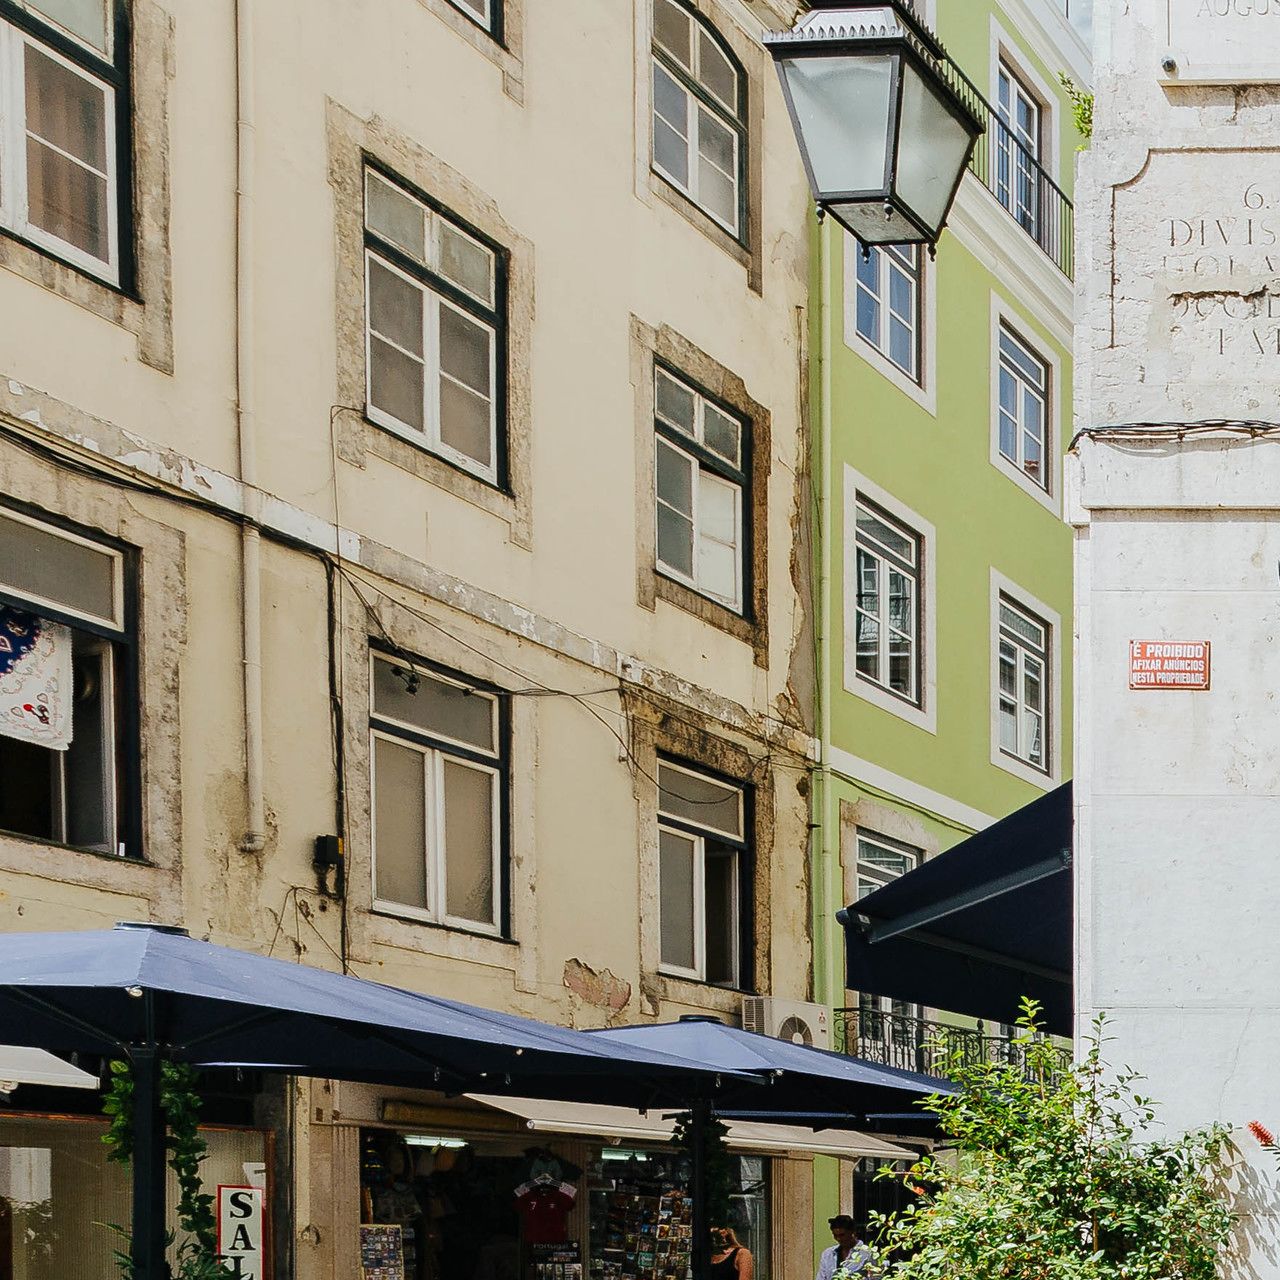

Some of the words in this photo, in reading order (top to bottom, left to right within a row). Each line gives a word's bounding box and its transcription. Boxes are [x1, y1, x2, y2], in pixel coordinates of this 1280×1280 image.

[1133, 641, 1142, 658] É
[1146, 644, 1204, 659] PROIBIDO
[1132, 659, 1162, 671] AFIXAR
[1163, 656, 1205, 672] ANÚNCIOS
[1132, 671, 1156, 684] NESTA
[1156, 671, 1205, 684] PROPRIEDADE
